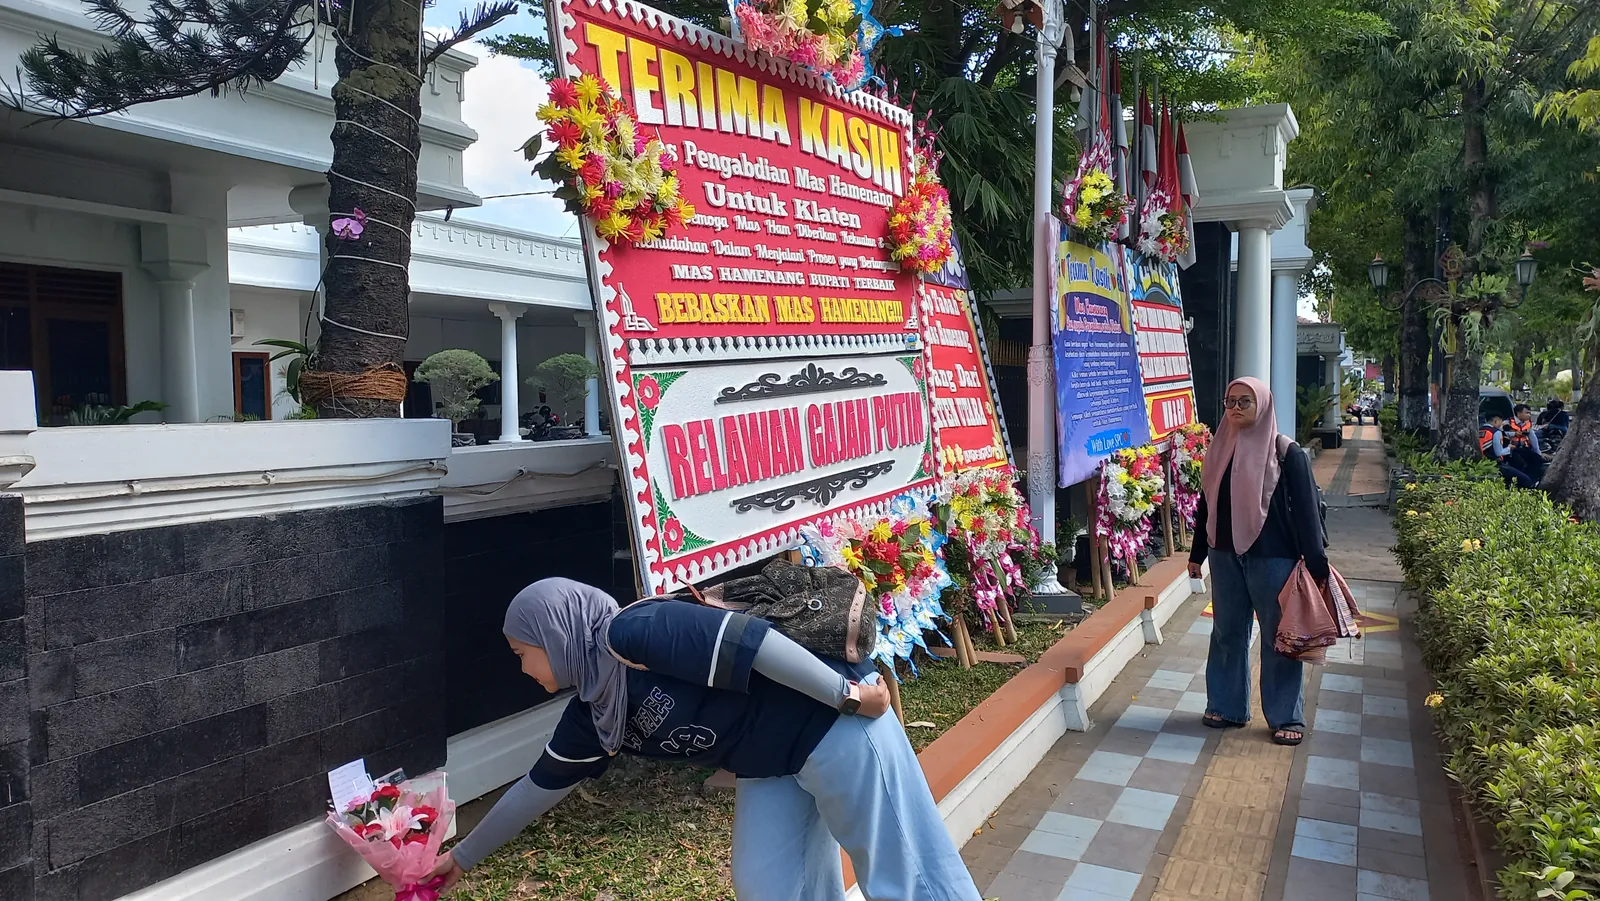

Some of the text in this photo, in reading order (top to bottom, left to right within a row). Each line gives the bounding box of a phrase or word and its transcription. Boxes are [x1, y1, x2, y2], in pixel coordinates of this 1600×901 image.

[582, 21, 903, 197] TERIMA KASIH
[682, 140, 790, 185] Pengabdian
[793, 166, 826, 193] Mas
[828, 174, 893, 211] Hamenang
[702, 181, 861, 229] Untuk Klaten
[733, 215, 761, 232] Mas
[764, 219, 791, 235] Ham
[711, 239, 752, 257] Dalam
[754, 244, 805, 265] Menjalani
[806, 249, 836, 265] Proses
[838, 256, 858, 271] yang
[670, 264, 896, 292] MAS HAMENANG BUPATI TERBAIK
[654, 292, 771, 324] BEBASKAN
[773, 295, 815, 323] MAS
[818, 297, 904, 323] HAMENANG!!!
[954, 363, 982, 388] Dari
[660, 391, 924, 500] RELAWAN GAJAH PUTIH
[1091, 438, 1104, 453] With
[1103, 435, 1115, 450] Love
